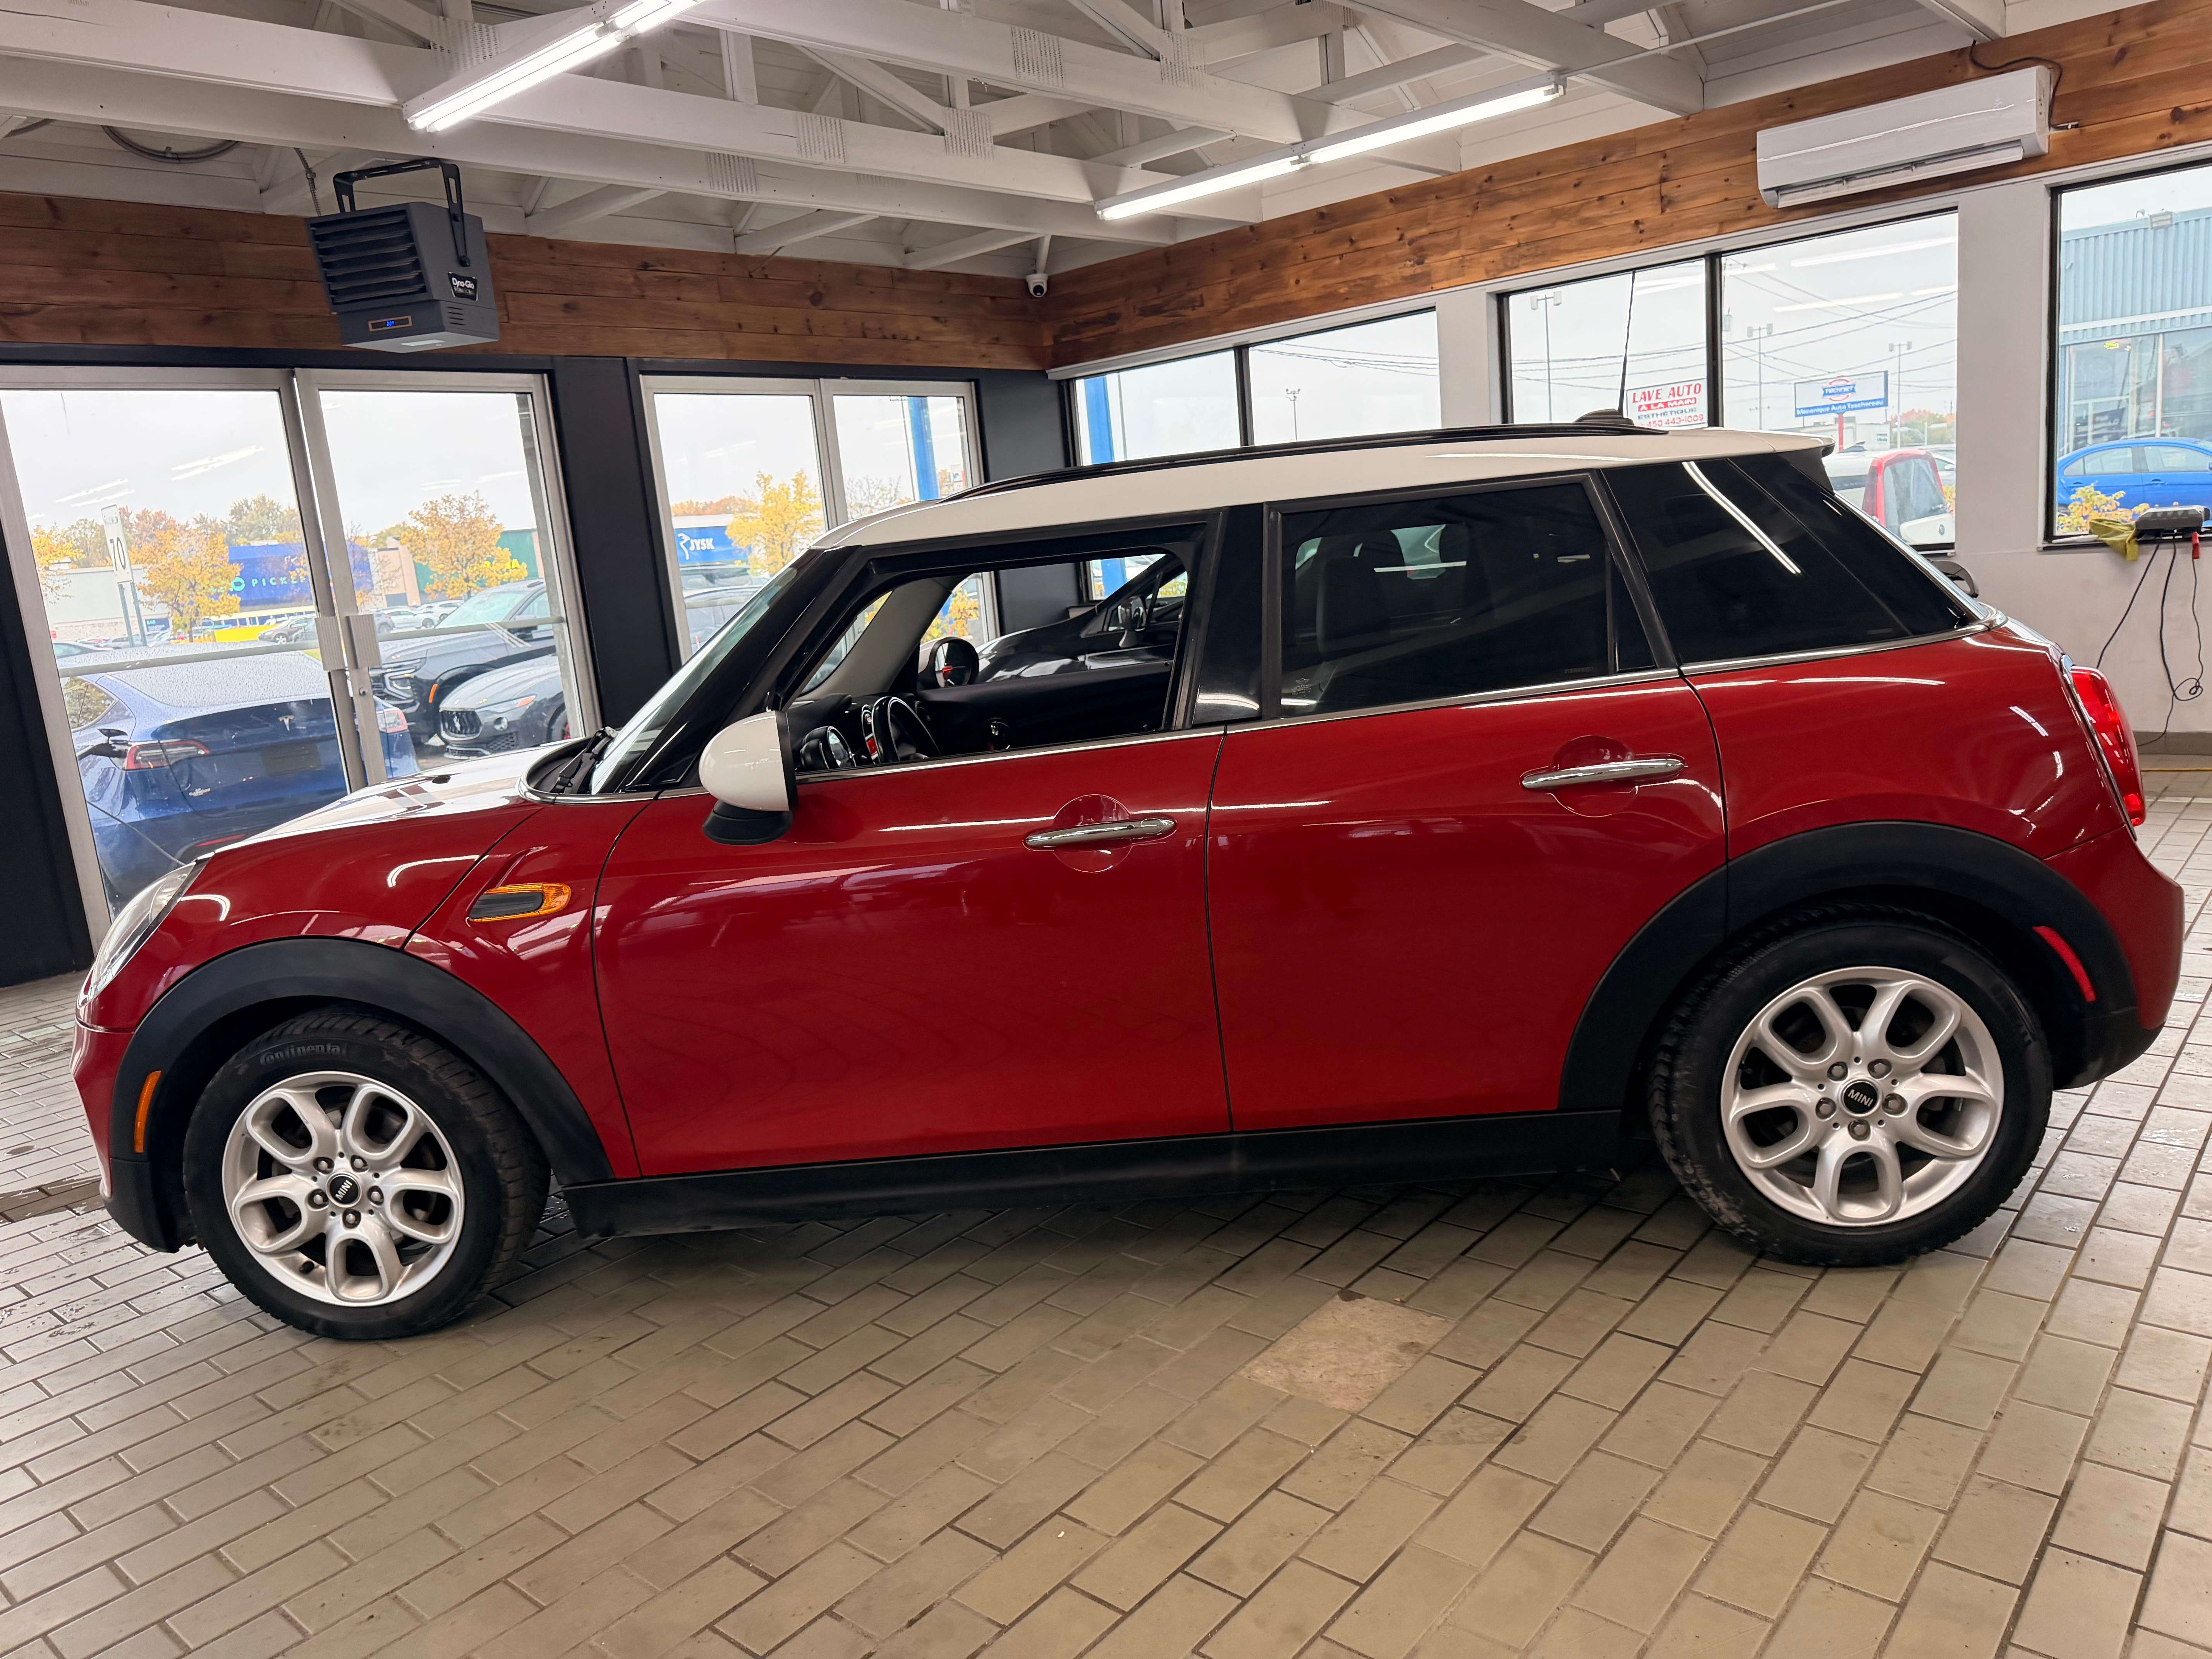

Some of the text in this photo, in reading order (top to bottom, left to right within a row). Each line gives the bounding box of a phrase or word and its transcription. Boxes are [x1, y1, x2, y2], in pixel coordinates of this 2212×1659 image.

[1632, 383, 1702, 403] LAVE AUTO
[1668, 398, 1695, 407] MAIN
[110, 537, 126, 571] 70
[689, 538, 715, 551] JYSK
[260, 1042, 347, 1065] Continental
[1848, 1089, 1874, 1107] MINI
[335, 1180, 352, 1200] MINI
